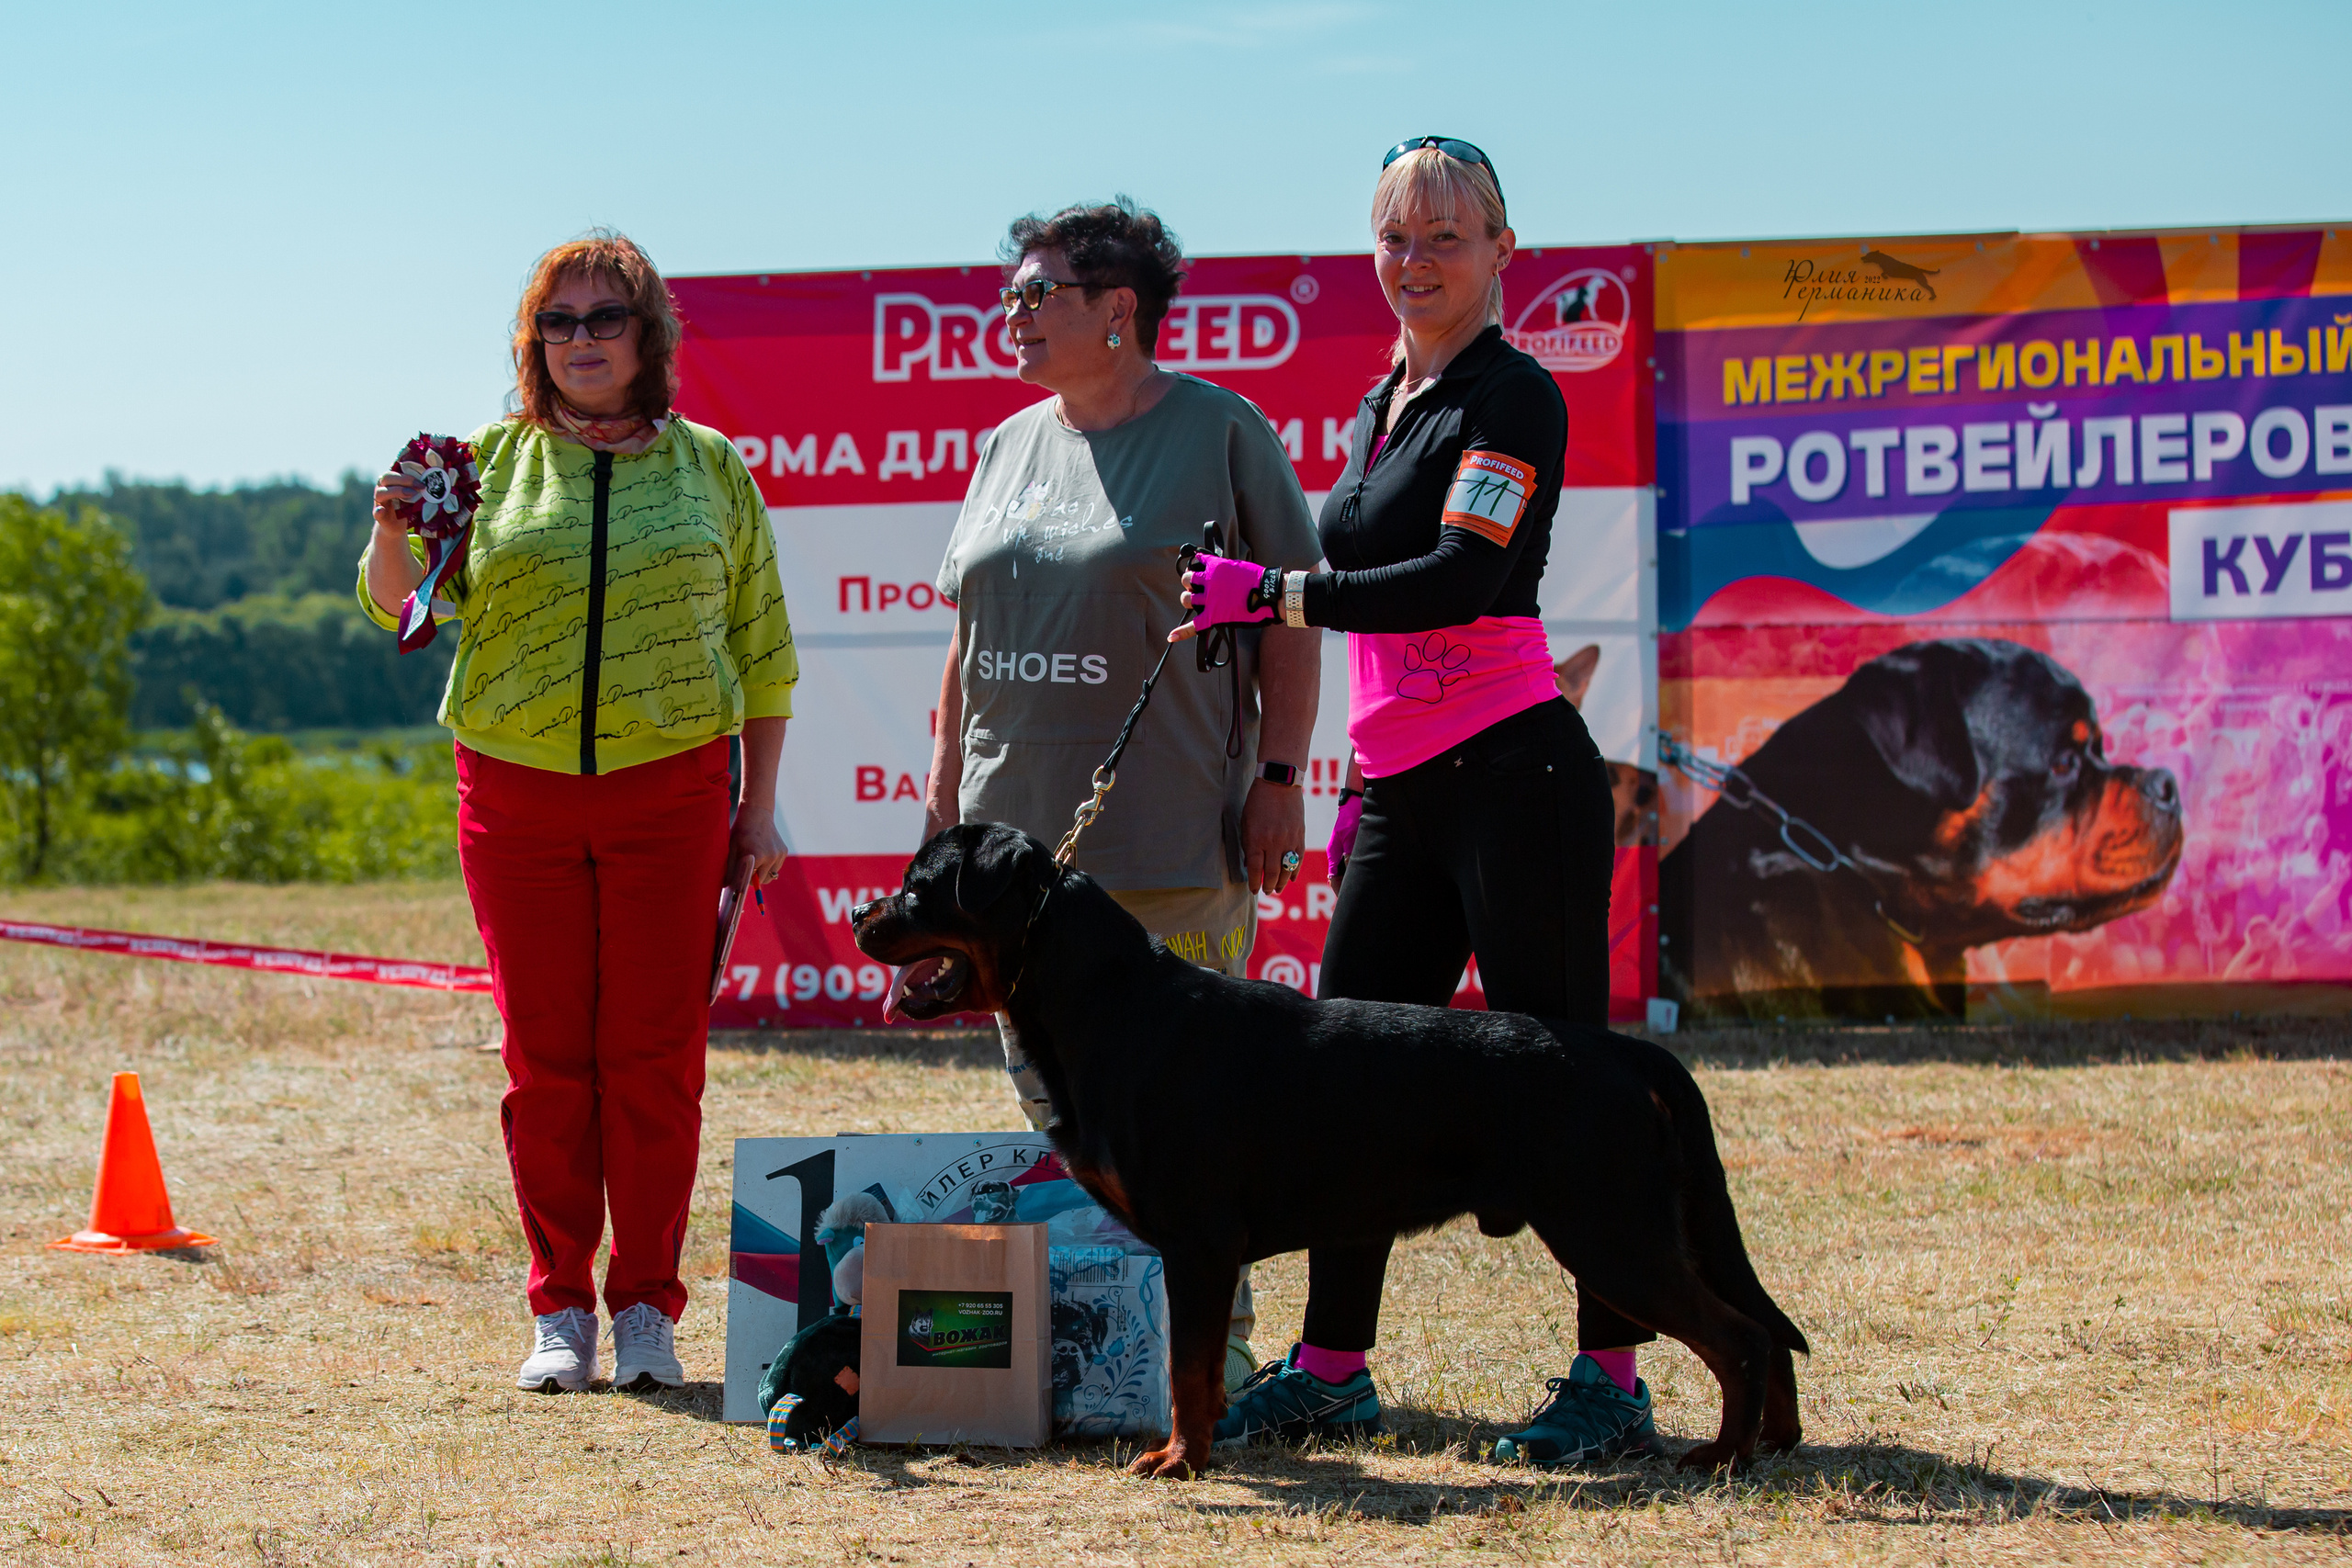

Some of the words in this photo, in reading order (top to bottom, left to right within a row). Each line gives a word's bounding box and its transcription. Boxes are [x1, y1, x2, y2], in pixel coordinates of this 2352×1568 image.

[1723, 312, 2352, 405] МЕЖРЕГИОНАЛЬНЫЙ
[732, 431, 865, 478] РМА
[1470, 455, 1524, 479] PROFIFEED
[1731, 401, 2352, 505] РОТВЕЙЛЕРОВ
[1466, 475, 1510, 516] 11
[978, 650, 1108, 684] SHOES
[933, 1324, 1007, 1347] ВОЖАК
